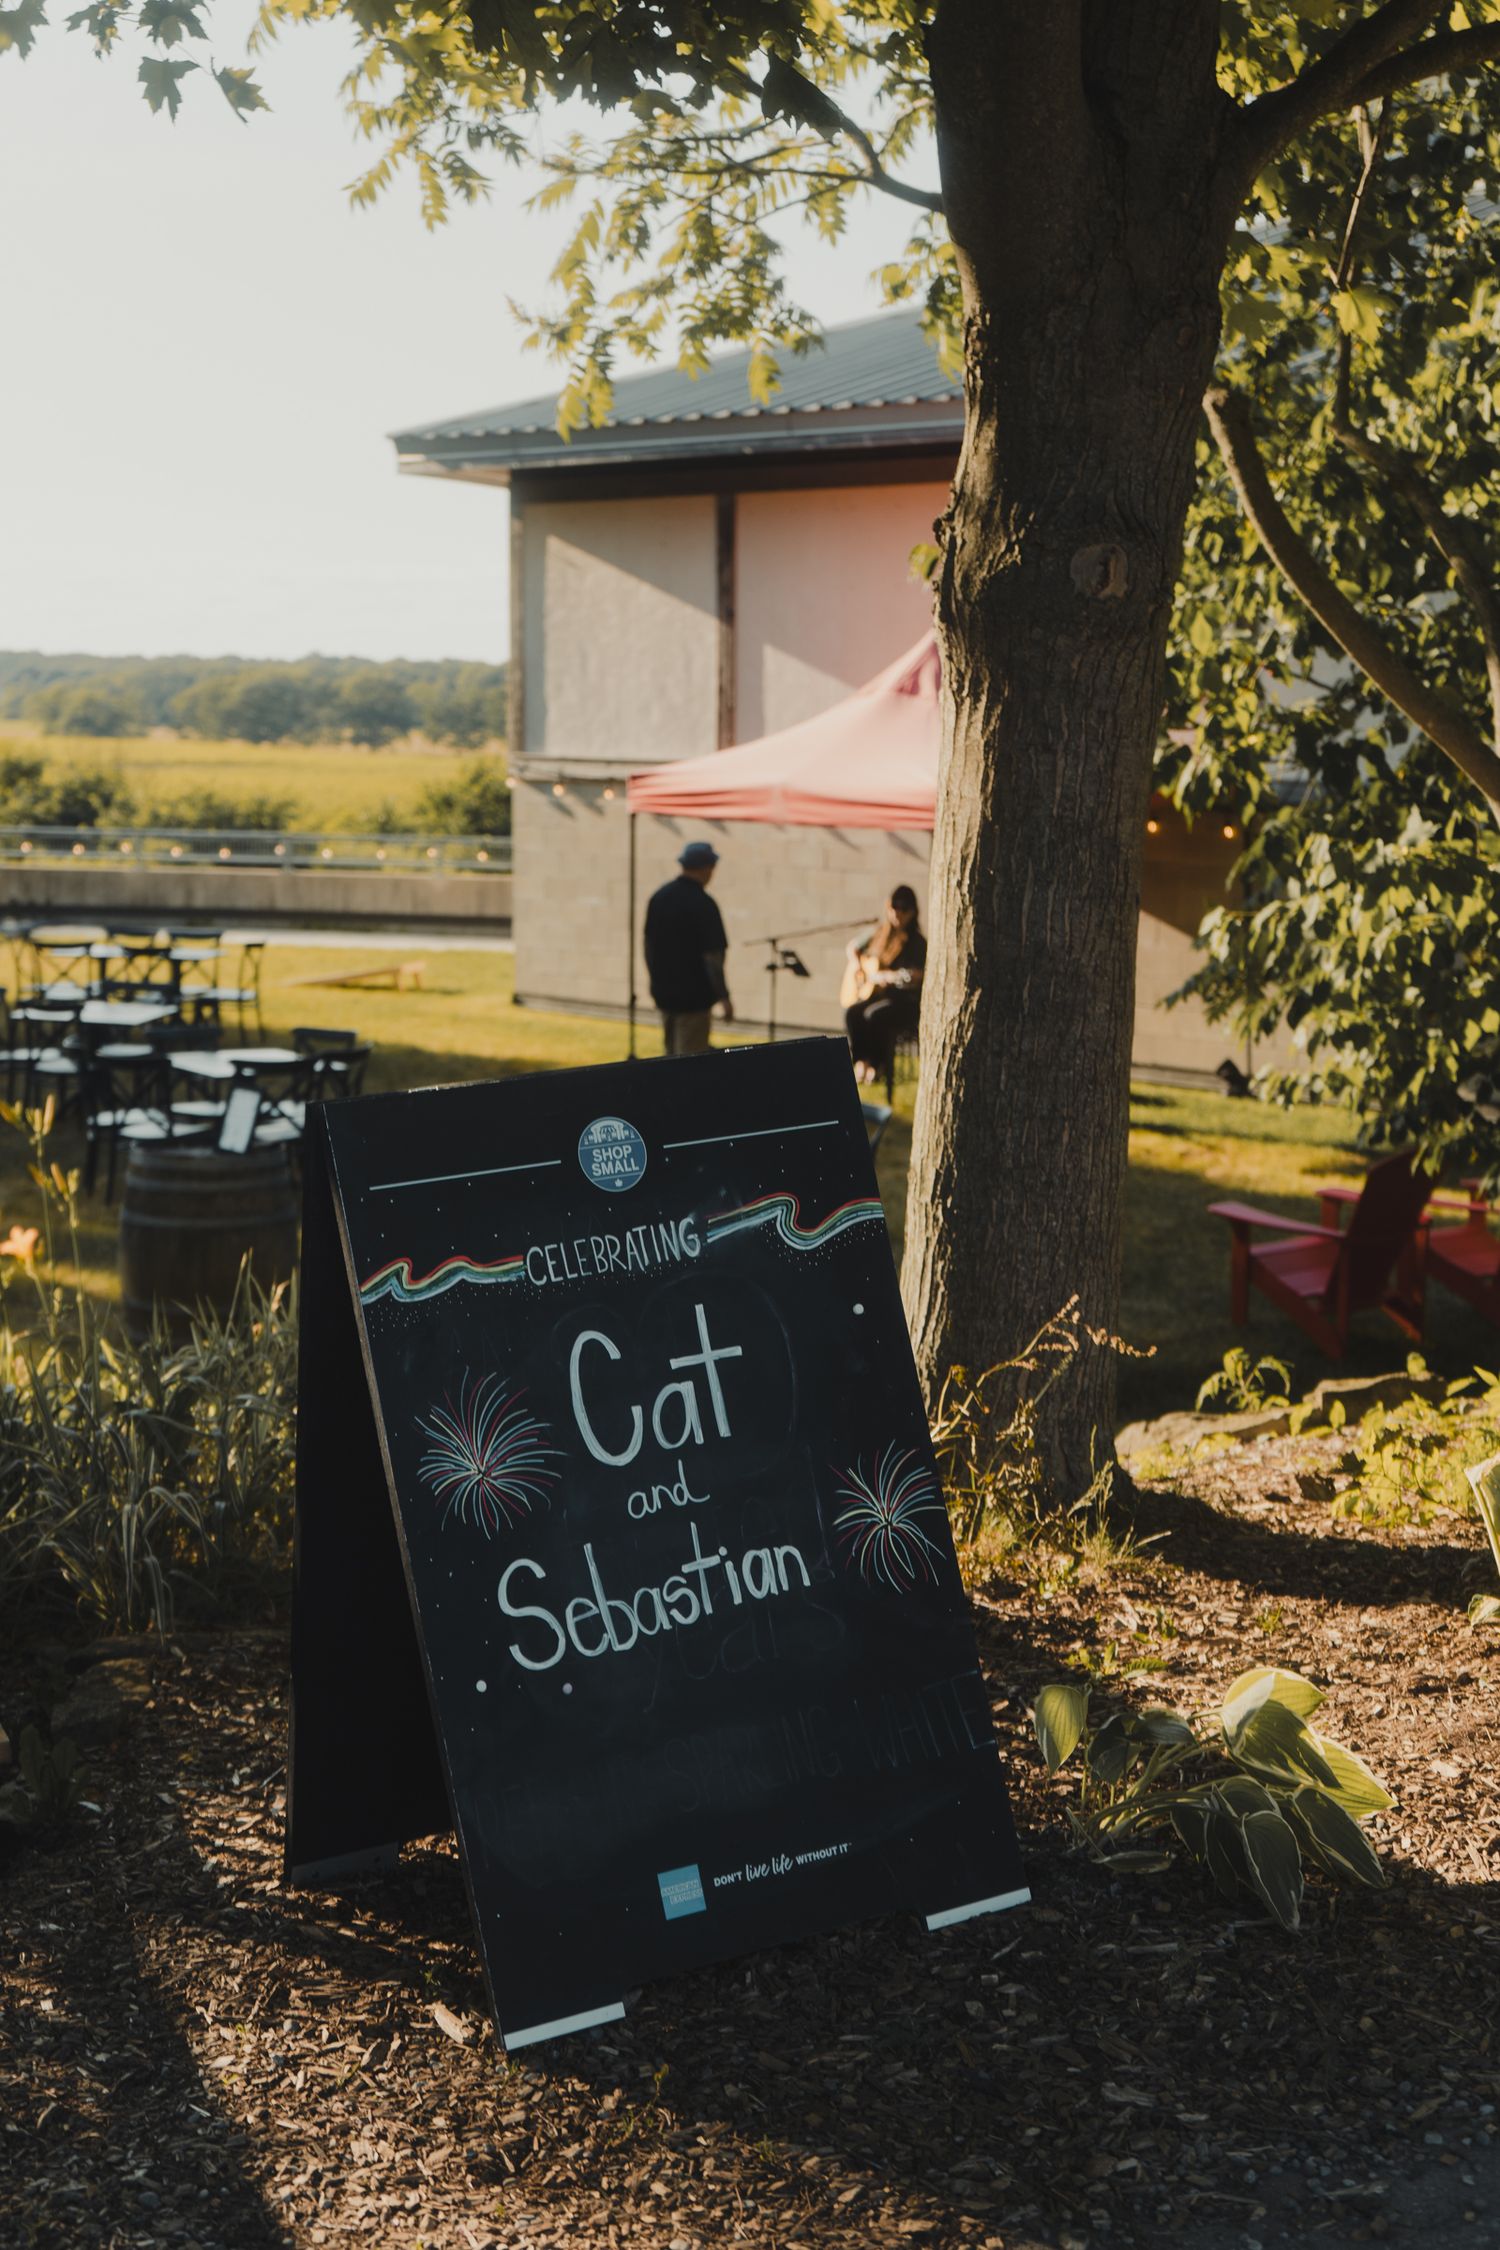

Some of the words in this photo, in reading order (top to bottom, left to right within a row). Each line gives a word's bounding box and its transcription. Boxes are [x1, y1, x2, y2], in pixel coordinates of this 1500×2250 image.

[592, 1158, 639, 1177] SMALL
[593, 1144, 632, 1163] SHOP
[526, 1218, 700, 1286] CELEBRATING
[570, 1304, 742, 1466] Cat
[628, 1459, 710, 1519] and
[498, 1522, 811, 1671] Sebastian
[713, 1871, 743, 1888] DON'T
[745, 1863, 770, 1882] live
[772, 1853, 794, 1875] life
[795, 1845, 838, 1865] WITHOUT
